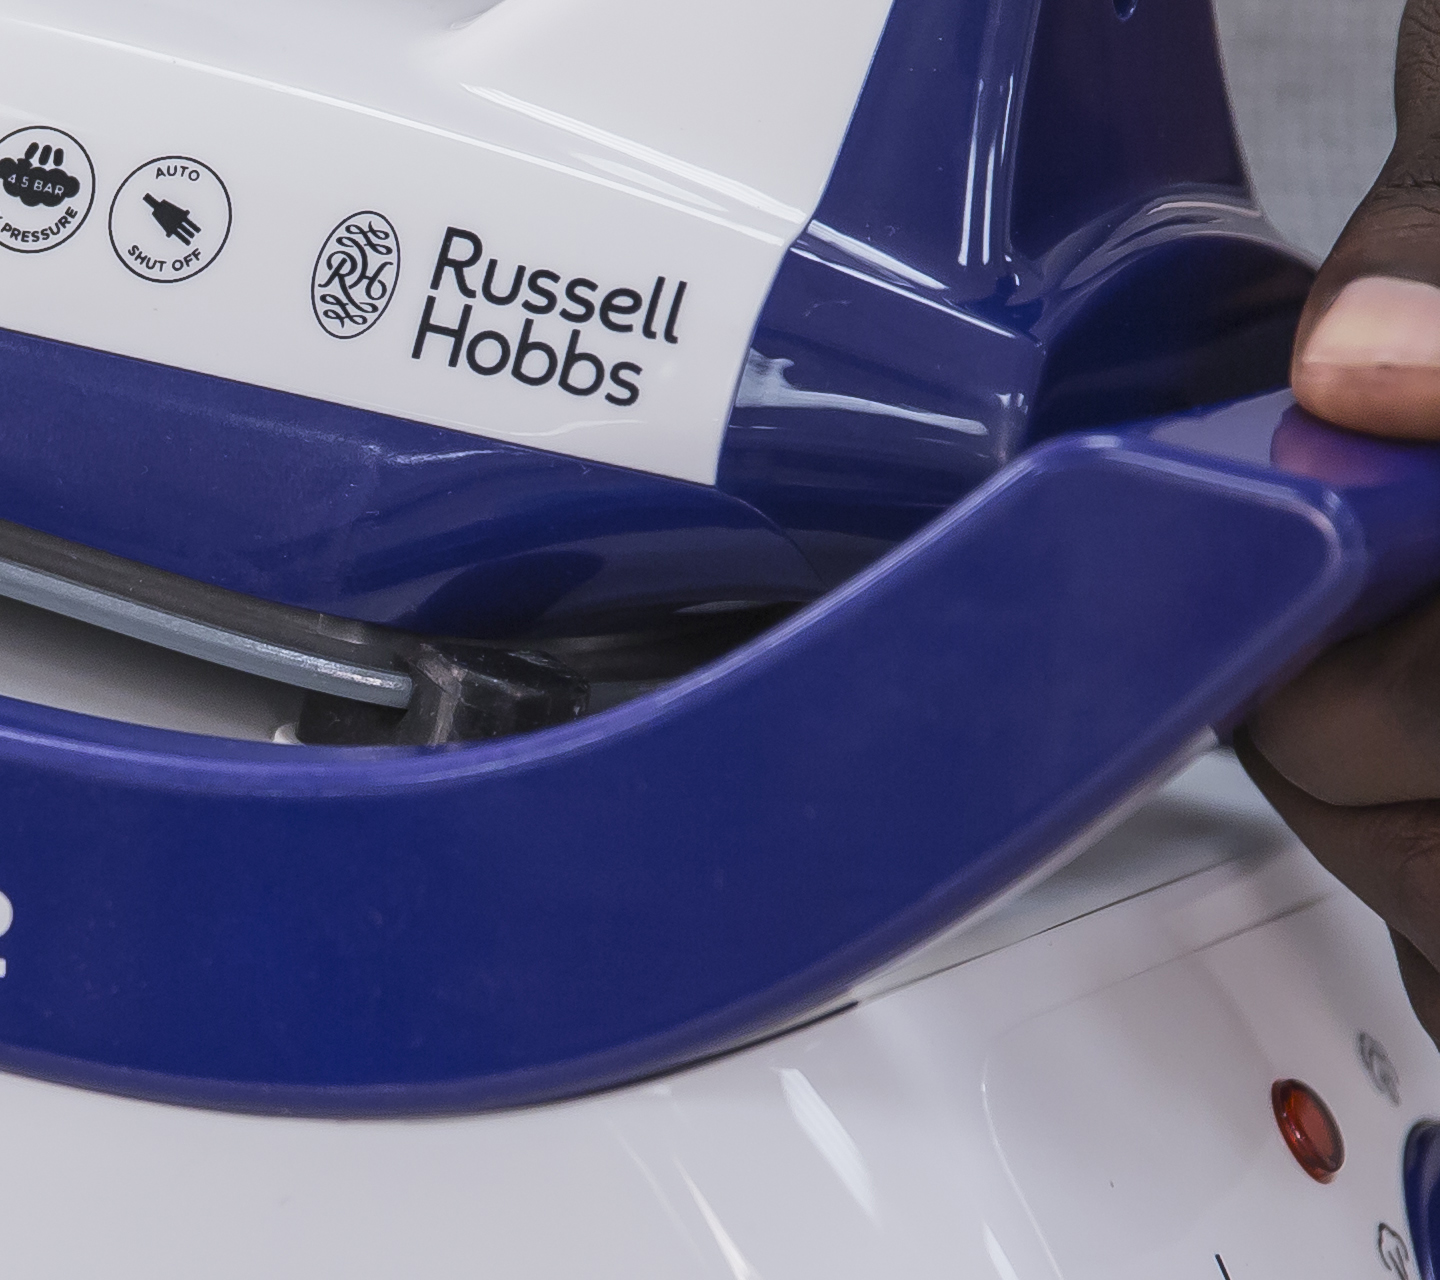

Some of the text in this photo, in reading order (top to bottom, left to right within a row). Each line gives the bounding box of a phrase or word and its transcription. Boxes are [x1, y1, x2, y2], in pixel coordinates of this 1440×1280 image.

[33, 179, 65, 197] BAR
[155, 164, 201, 182] AUTO
[0, 206, 79, 243] PRESSURE
[127, 244, 202, 272] SHUT OFF
[430, 226, 688, 344] Russell
[411, 295, 643, 407] Hobbs
